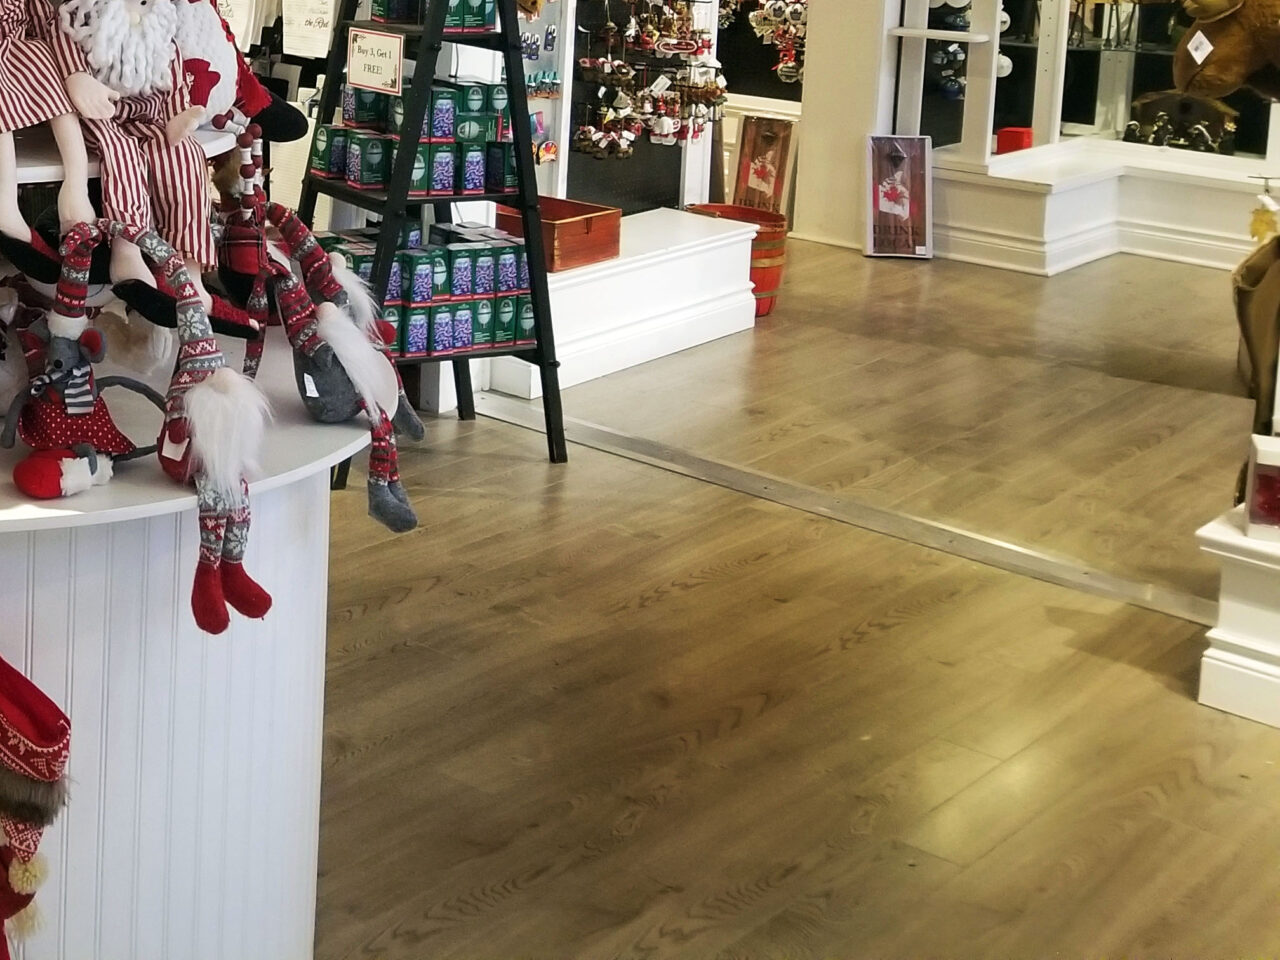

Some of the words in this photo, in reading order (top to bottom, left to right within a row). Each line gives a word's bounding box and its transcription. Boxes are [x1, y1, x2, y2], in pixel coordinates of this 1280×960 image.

[358, 45, 368, 57] Buy
[377, 49, 387, 59] Get
[363, 64, 383, 75] FREE!
[873, 224, 922, 237] DRINK
